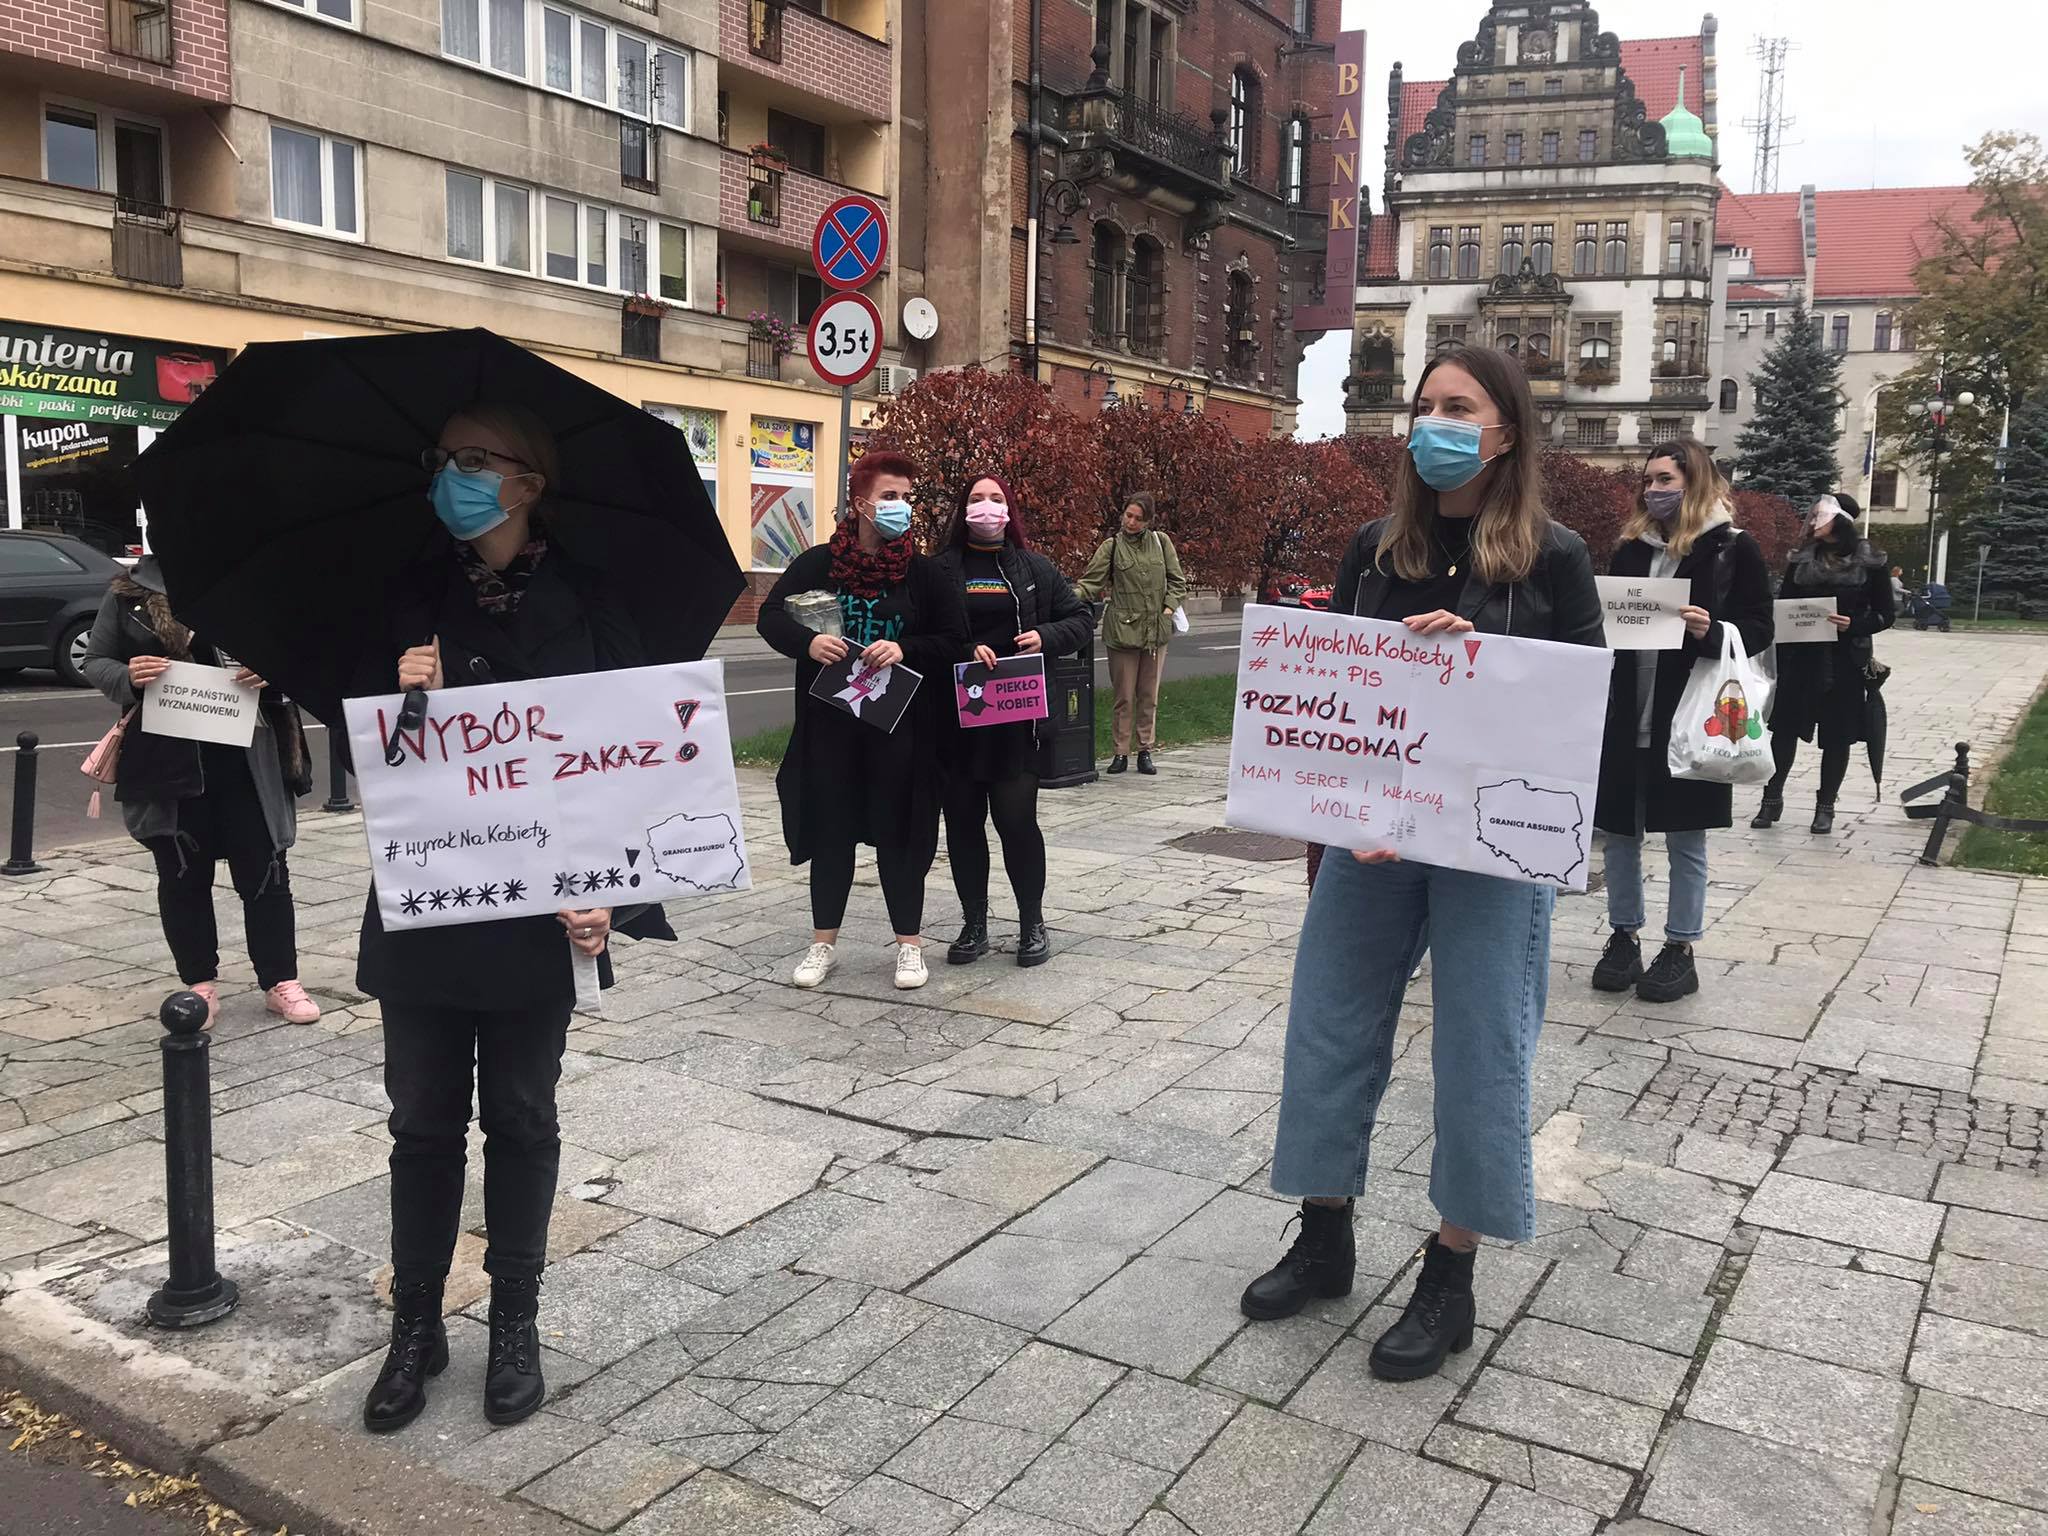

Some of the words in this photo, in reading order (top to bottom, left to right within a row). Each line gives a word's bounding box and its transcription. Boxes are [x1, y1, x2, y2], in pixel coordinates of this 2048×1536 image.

[1329, 63, 1359, 230] BANK
[0, 364, 117, 396] skórzana
[38, 400, 75, 412] paski
[89, 404, 138, 420] portfele
[22, 422, 89, 450] kupon
[1627, 588, 1642, 597] NIE
[1608, 601, 1626, 610] DLA
[1617, 615, 1651, 625] KOBIET
[1347, 665, 1382, 687] PIS
[162, 684, 189, 696] STOP
[191, 688, 240, 704] PAŃSTWU
[995, 679, 1038, 694] PIEKŁO
[158, 698, 240, 718] WYZNANIOWEMU
[997, 696, 1040, 711] KOBIET
[1241, 691, 1356, 725] POZWÓL
[1377, 704, 1408, 730] MI
[377, 701, 564, 763] WYBÓR
[1264, 725, 1428, 764] DECYDOWAĆ
[466, 757, 528, 796] NIE
[1241, 764, 1281, 783] MAM
[1294, 770, 1349, 789] SERCE
[1489, 817, 1525, 828] GRANICE
[1526, 822, 1566, 834] ABSURDU
[662, 847, 692, 856] GRANICE
[693, 843, 725, 852] ABSURDU
